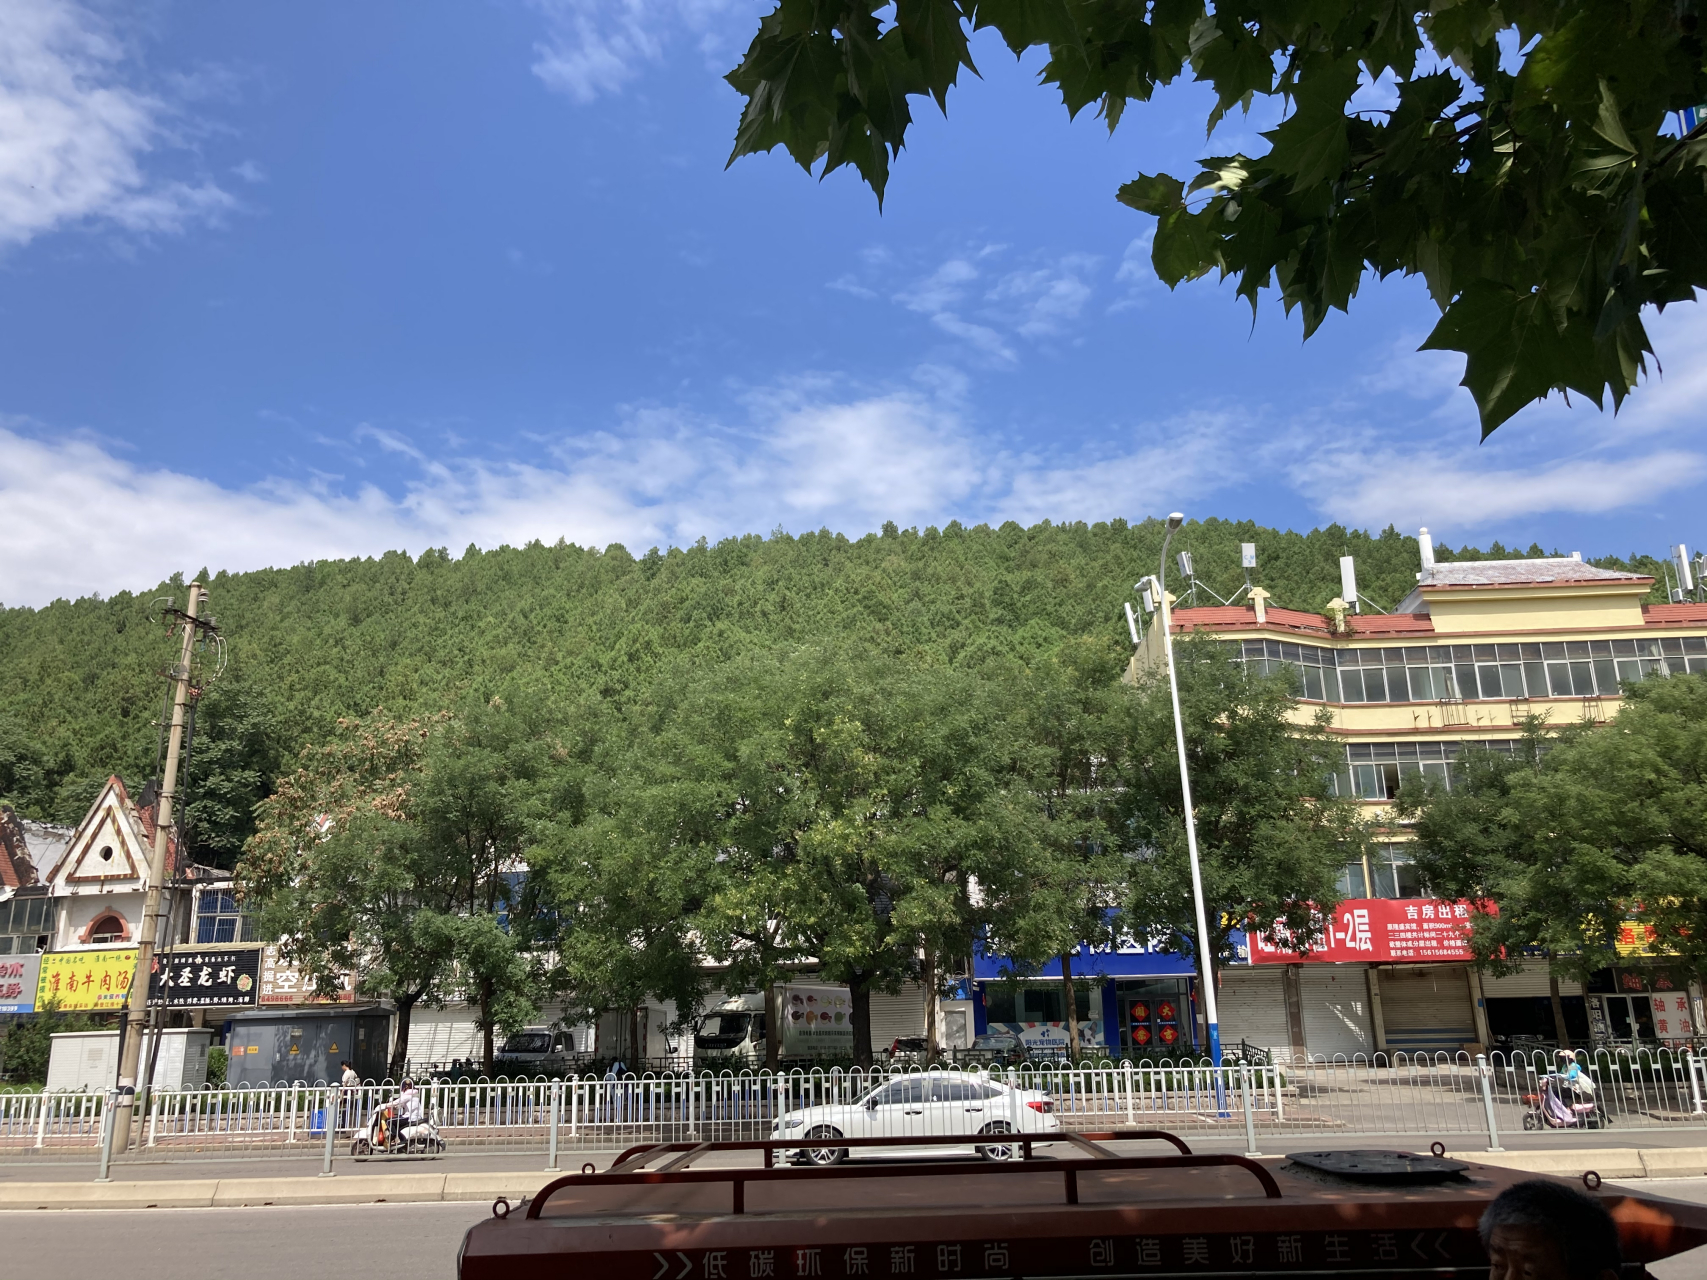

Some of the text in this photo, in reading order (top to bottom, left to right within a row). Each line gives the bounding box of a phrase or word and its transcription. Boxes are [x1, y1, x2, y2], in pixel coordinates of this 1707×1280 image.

[1404, 904, 1469, 919] 吉房出租
[48, 969, 130, 993] 淮南牛肉汤
[159, 965, 237, 987] 大圣龙虾
[1653, 996, 1688, 1013] 轴承
[1657, 1018, 1692, 1034] 黄油
[1089, 1233, 1400, 1266] 创造美好新生活
[702, 1243, 1010, 1279] 低碳环保新时尚
